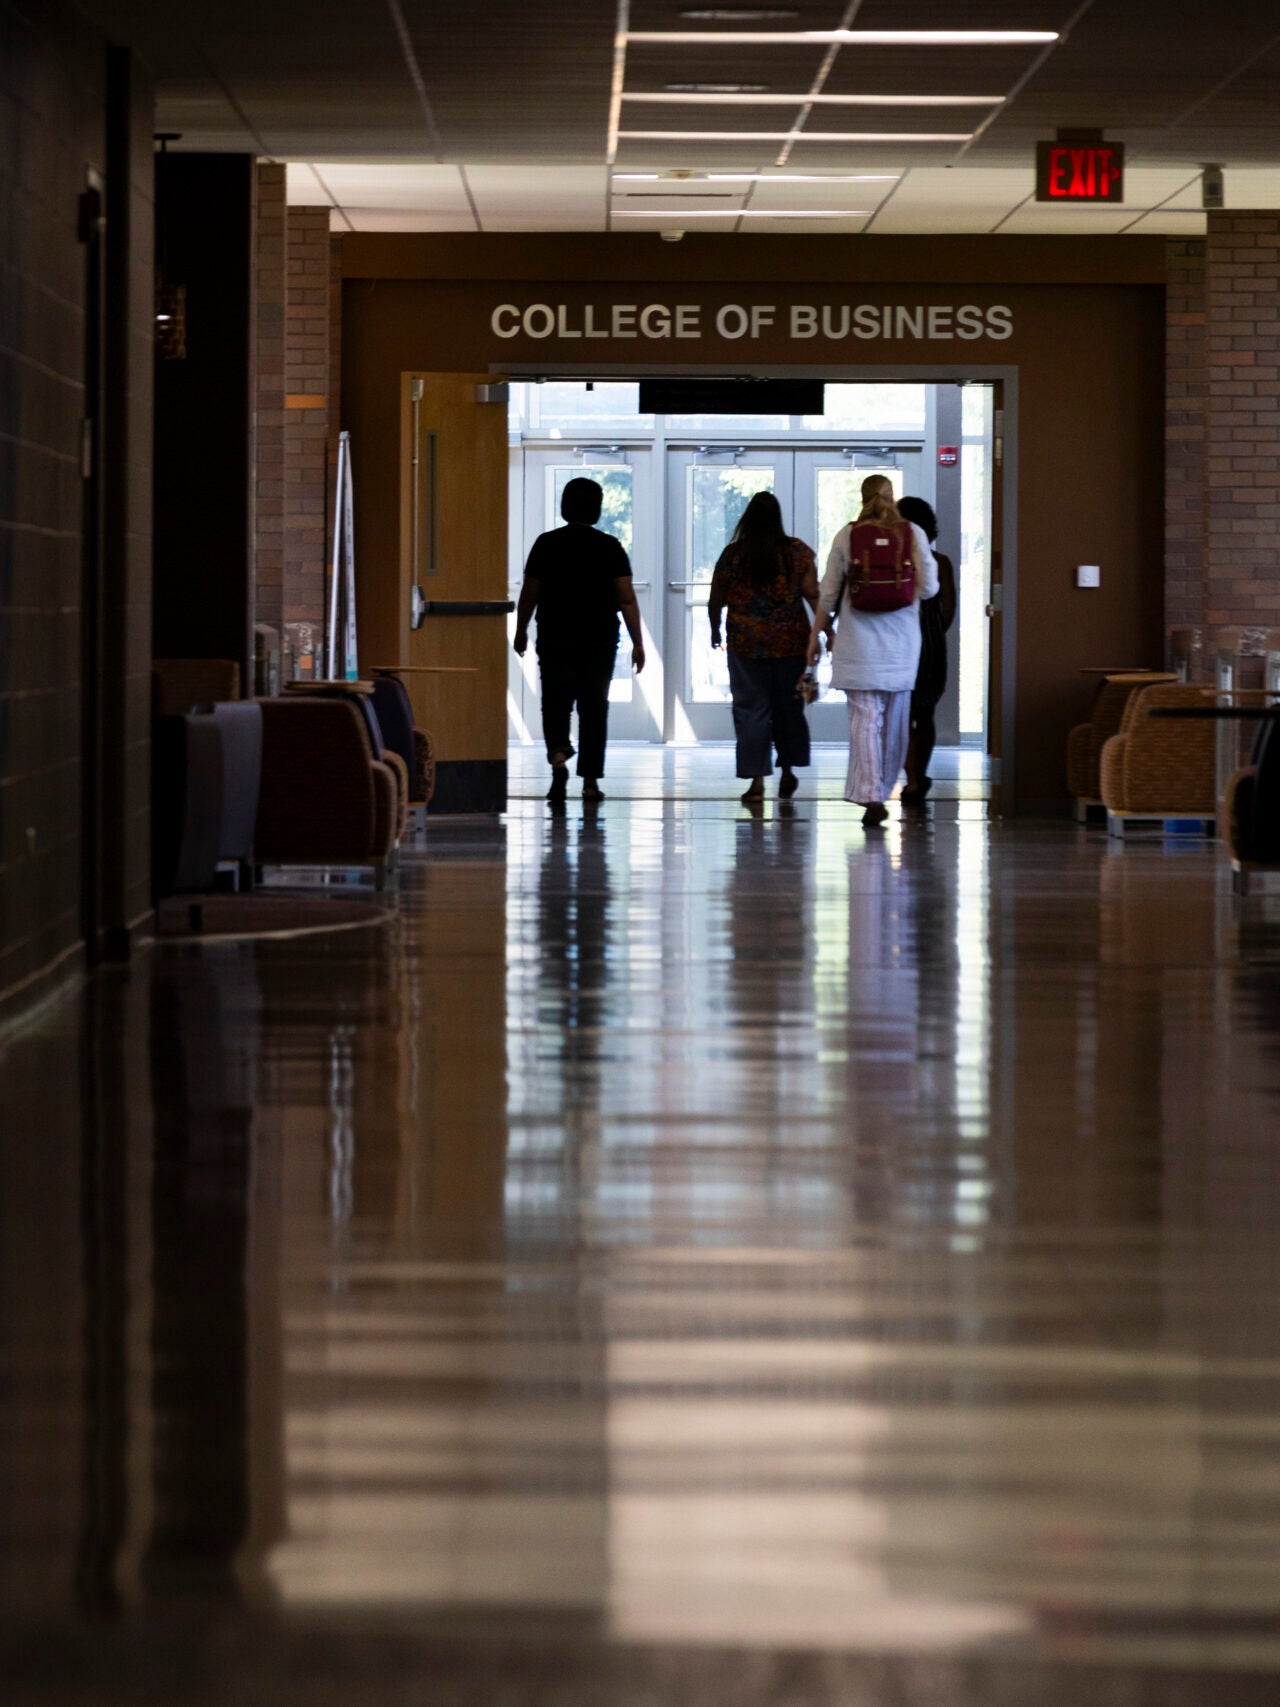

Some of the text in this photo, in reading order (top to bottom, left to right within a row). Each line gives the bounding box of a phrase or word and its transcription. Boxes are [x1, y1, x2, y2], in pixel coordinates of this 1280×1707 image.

[1048, 147, 1115, 198] EXIT
[491, 304, 1013, 340] COLLEGE OF BUSINESS
